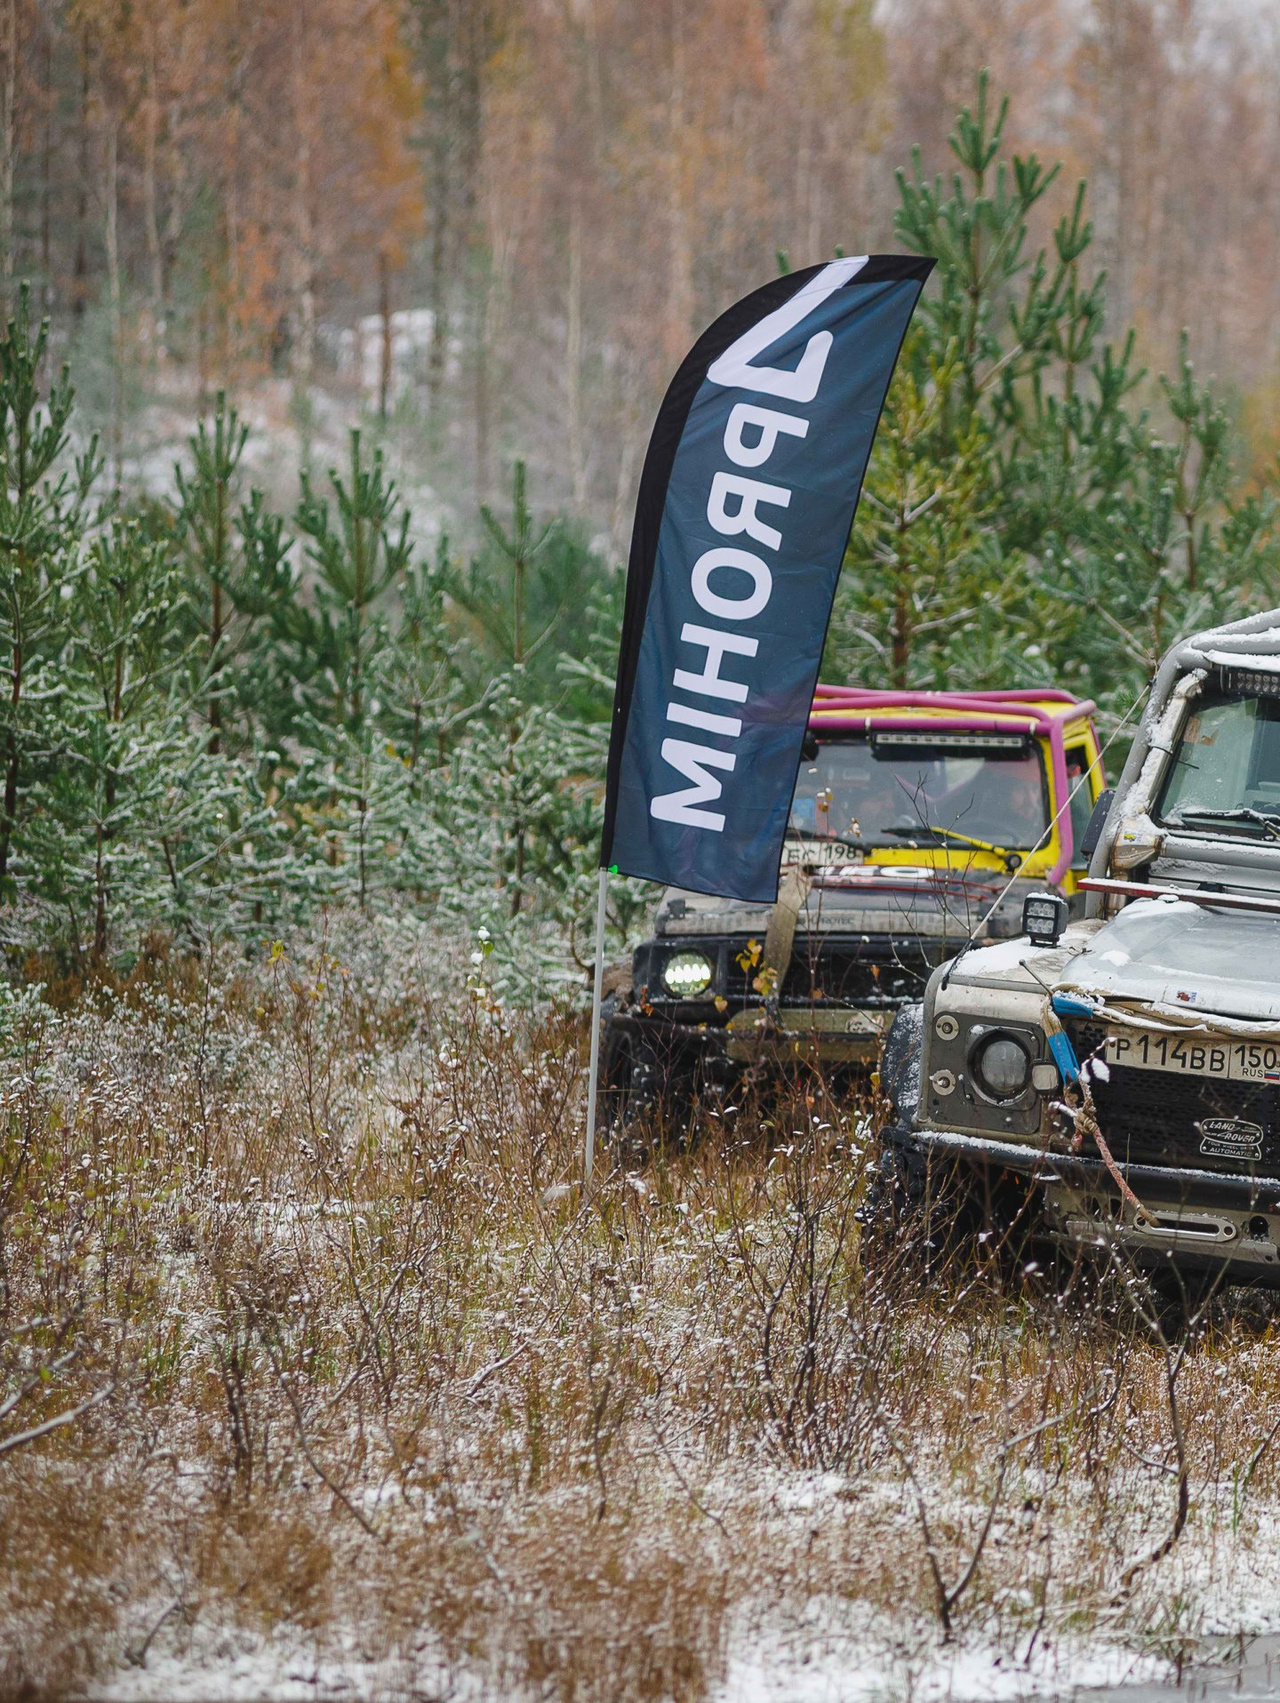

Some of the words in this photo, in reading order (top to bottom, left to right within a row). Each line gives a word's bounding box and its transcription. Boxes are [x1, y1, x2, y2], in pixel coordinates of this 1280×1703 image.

[1234, 1044, 1277, 1070] 150
[1242, 1067, 1264, 1078] RUS
[1209, 1121, 1236, 1131] LAND
[1224, 1132, 1256, 1143] ROVER
[1209, 1147, 1253, 1157] AUTOMATIC
